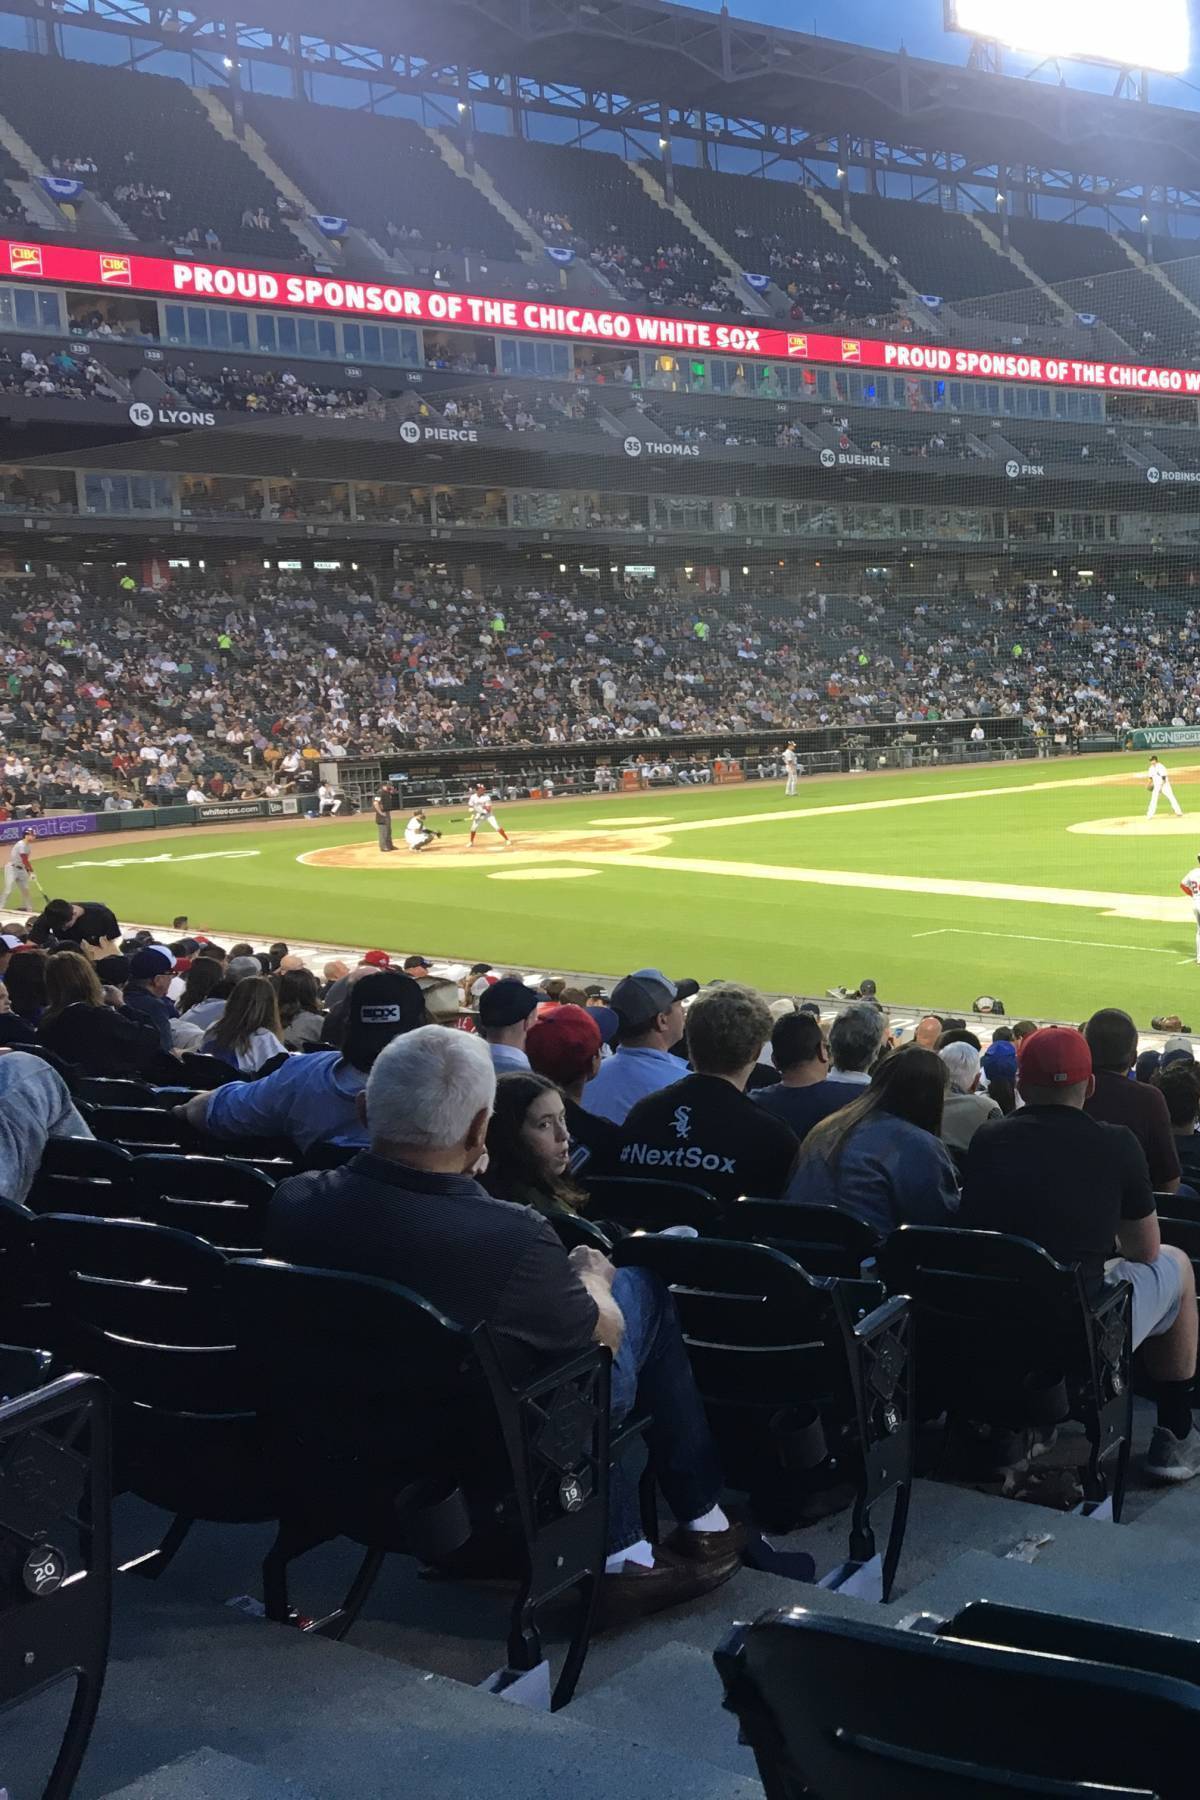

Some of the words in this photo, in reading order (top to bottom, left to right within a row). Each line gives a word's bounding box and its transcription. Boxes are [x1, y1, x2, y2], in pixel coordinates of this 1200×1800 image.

[12, 247, 40, 262] CIBC
[102, 258, 129, 272] CIBC
[173, 264, 278, 299] PROUD
[287, 278, 422, 316] SPONSOR
[428, 296, 461, 320] OF
[467, 299, 518, 327] THE
[524, 306, 631, 338] CHICAGO
[634, 318, 711, 347] WHITE
[715, 327, 761, 351] SOX
[885, 345, 951, 369] PROUD
[955, 352, 1041, 378] SPONSOR
[1046, 362, 1068, 380] OF
[1072, 363, 1105, 384] THE
[1109, 366, 1181, 390] CHICAGO
[134, 409, 149, 421] 16
[158, 409, 215, 426] LYONS
[403, 426, 418, 440] 19
[424, 427, 478, 443] PIERCE
[626, 440, 640, 453] 35
[645, 442, 700, 456] THOMAS
[822, 453, 834, 464] 56
[838, 453, 890, 467] BUEHRLE
[1007, 465, 1019, 475] 72
[1022, 465, 1044, 476] FISK
[1144, 731, 1175, 744] WGN
[202, 806, 258, 816] whitesox.com
[363, 1007, 397, 1017] SOX
[620, 1143, 736, 1175] #NextSox
[565, 1488, 578, 1502] 19
[34, 1563, 55, 1582] 20
